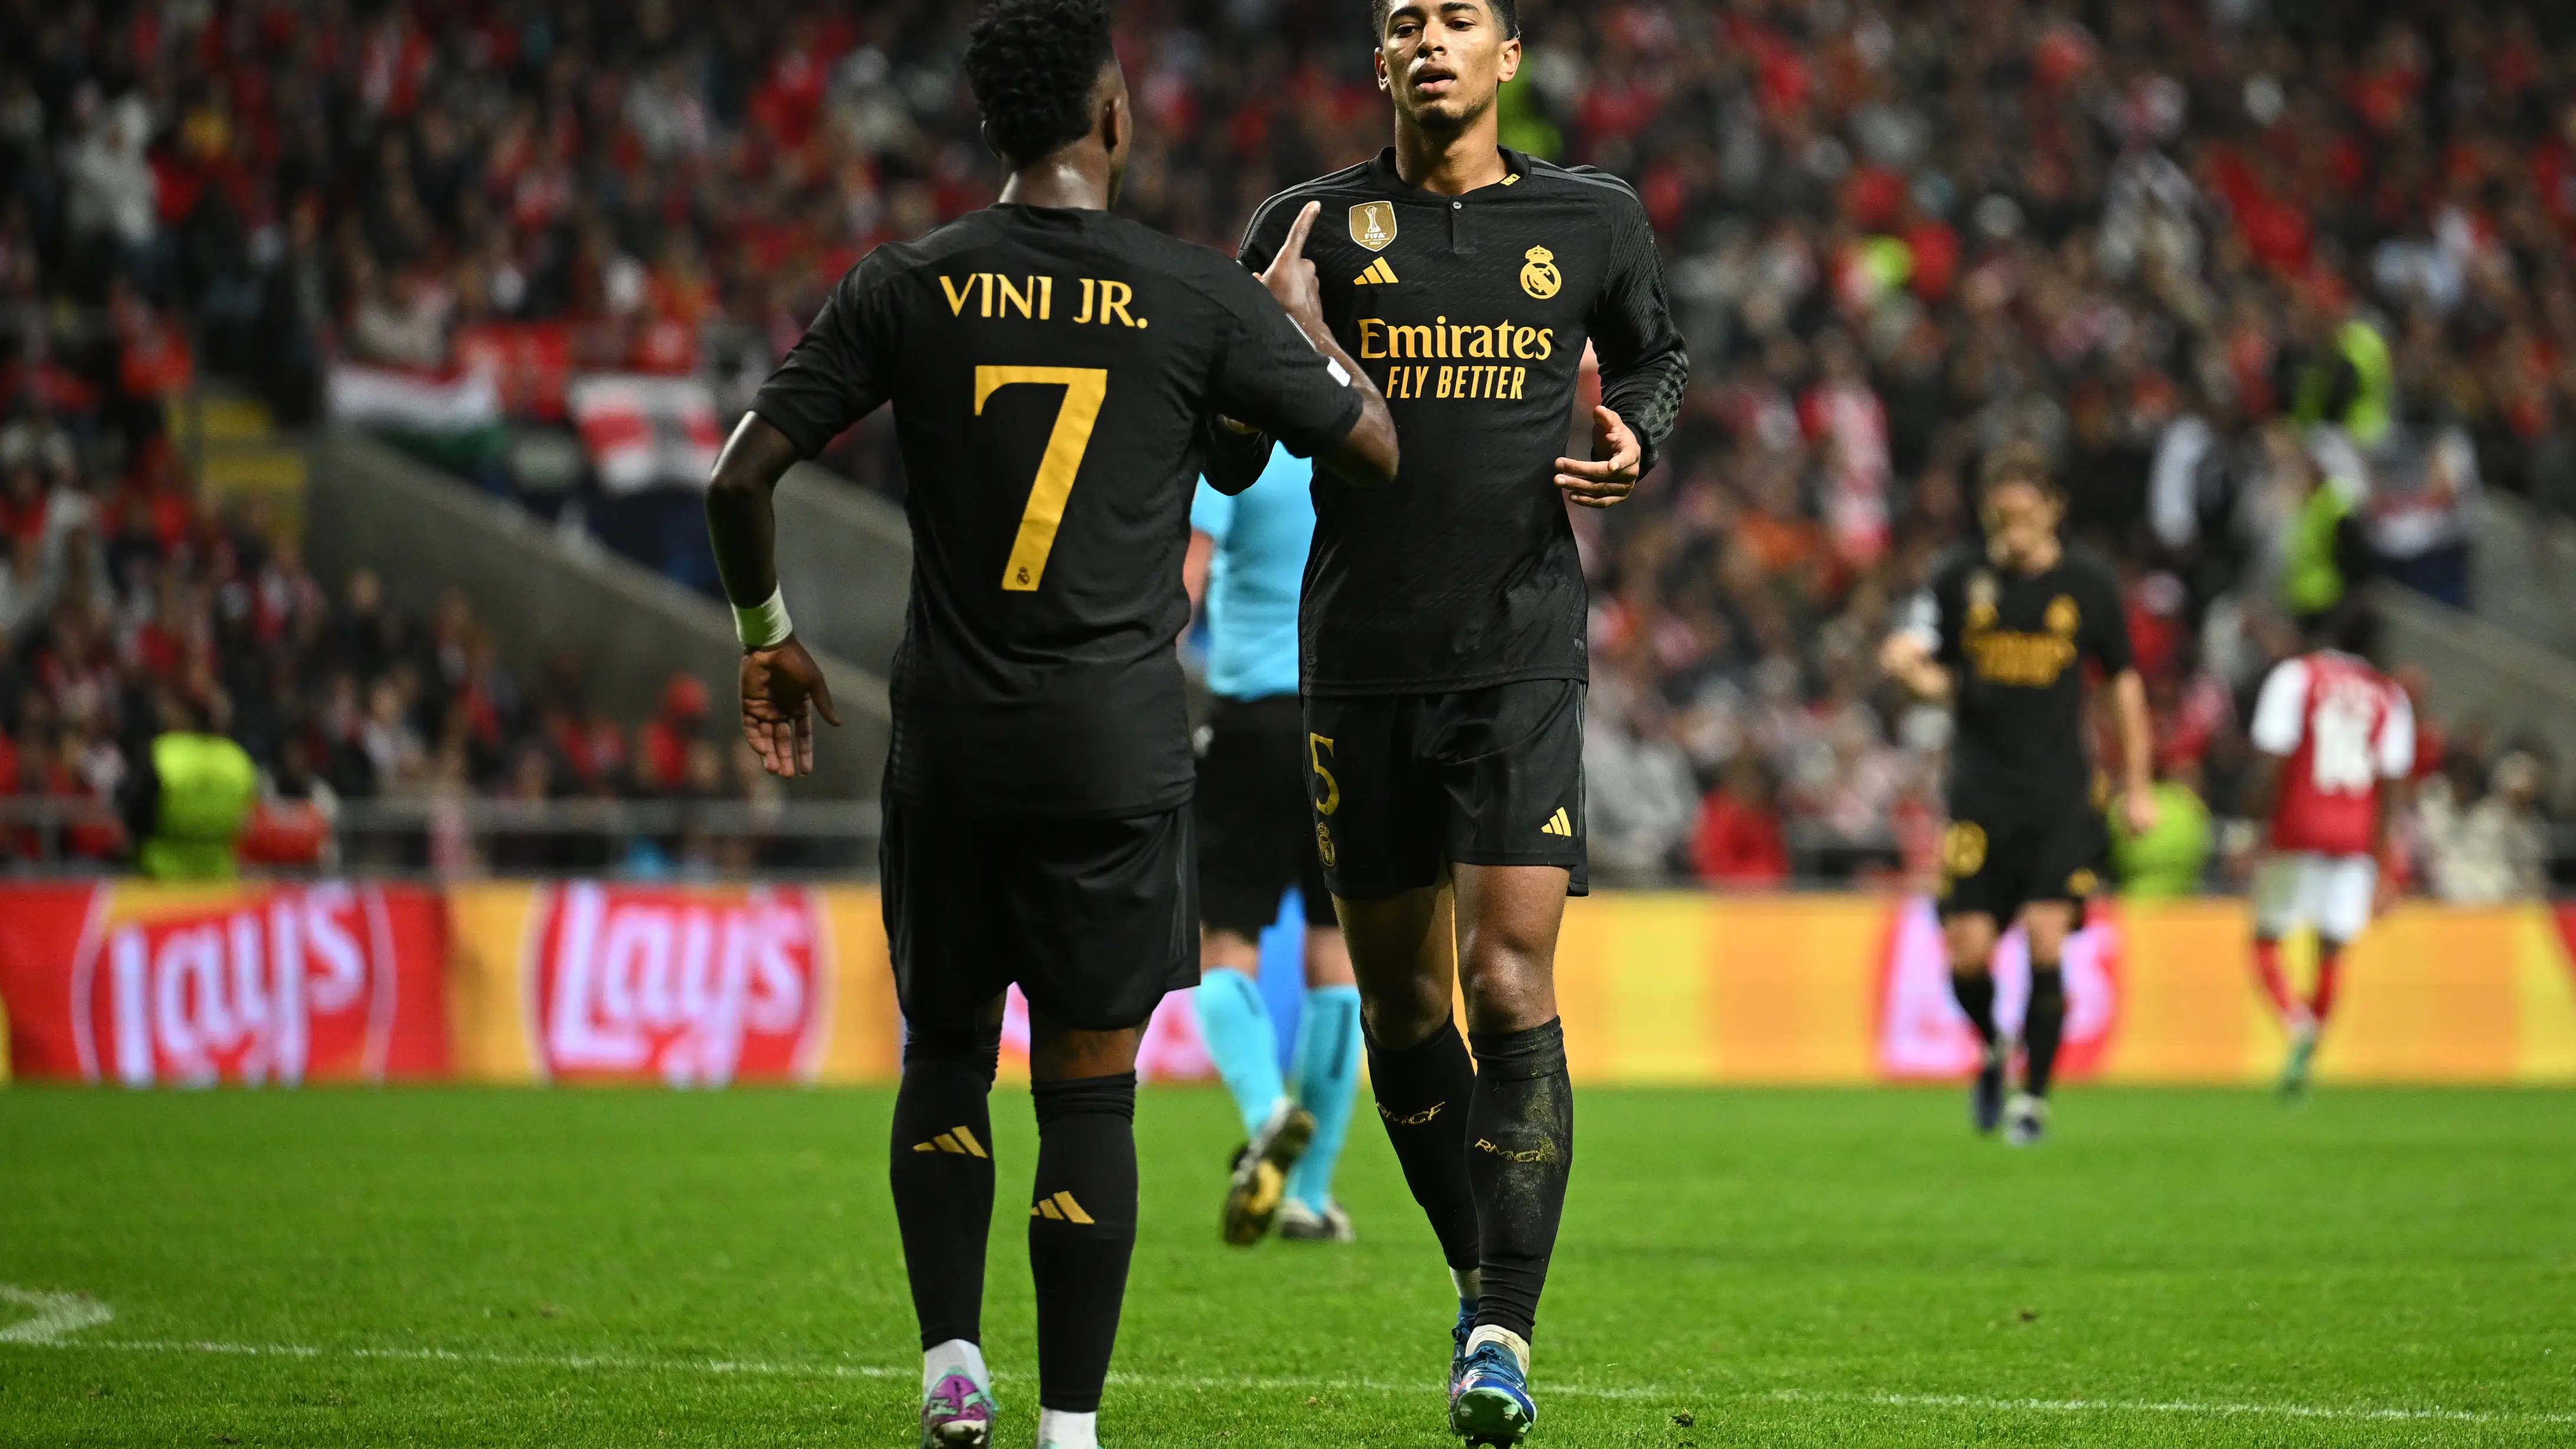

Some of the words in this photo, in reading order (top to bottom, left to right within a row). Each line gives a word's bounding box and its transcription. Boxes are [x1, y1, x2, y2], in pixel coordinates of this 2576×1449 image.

[939, 273, 1052, 320] VINI
[1072, 278, 1148, 328] JR.
[1357, 315, 1554, 360] Emirates
[1386, 365, 1429, 399] FLY
[1436, 365, 1526, 400] BETTER
[975, 365, 1108, 591] 7
[1310, 732, 1340, 816] 5
